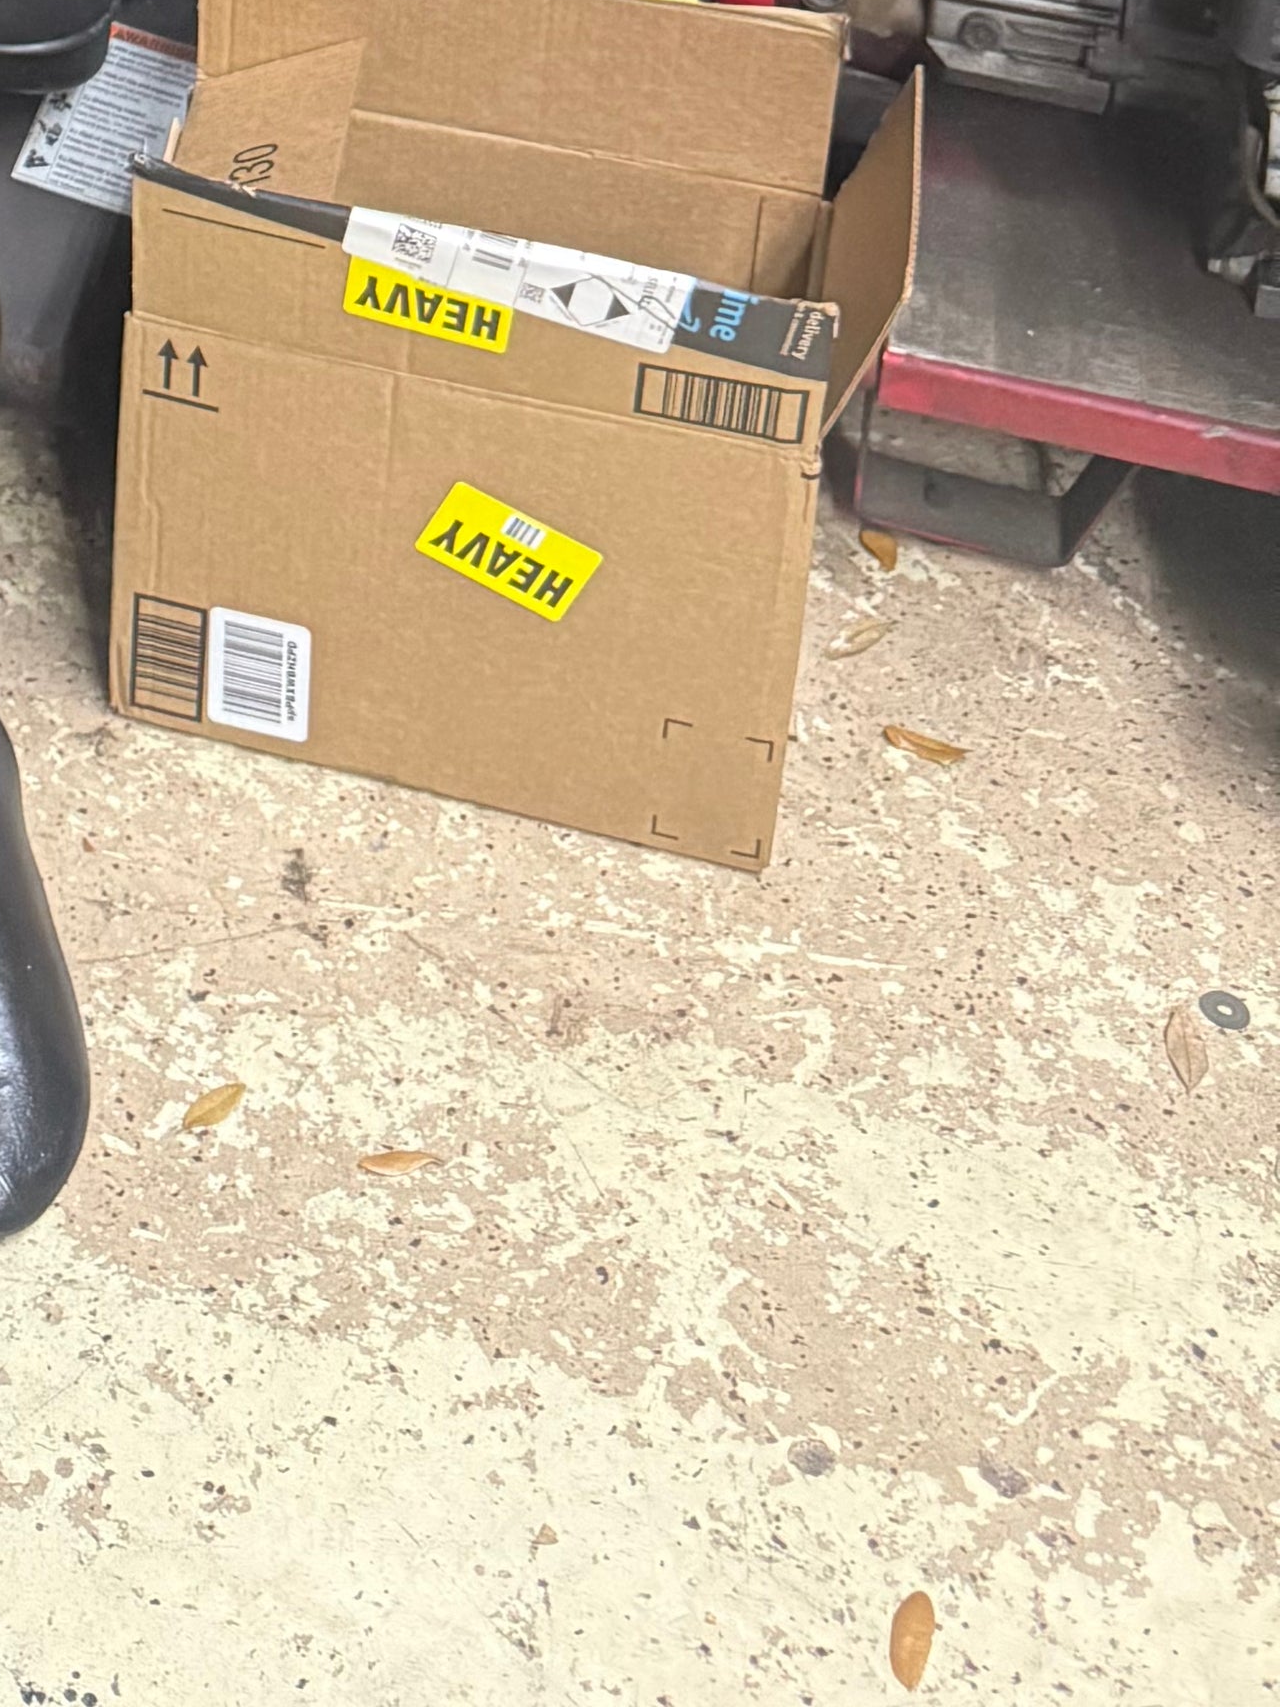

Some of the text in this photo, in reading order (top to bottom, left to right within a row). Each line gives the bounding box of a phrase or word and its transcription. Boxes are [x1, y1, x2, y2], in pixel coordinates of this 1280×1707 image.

[355, 275, 501, 341] HEAVY
[791, 311, 825, 361] delivery
[428, 519, 574, 608] HEAVY
